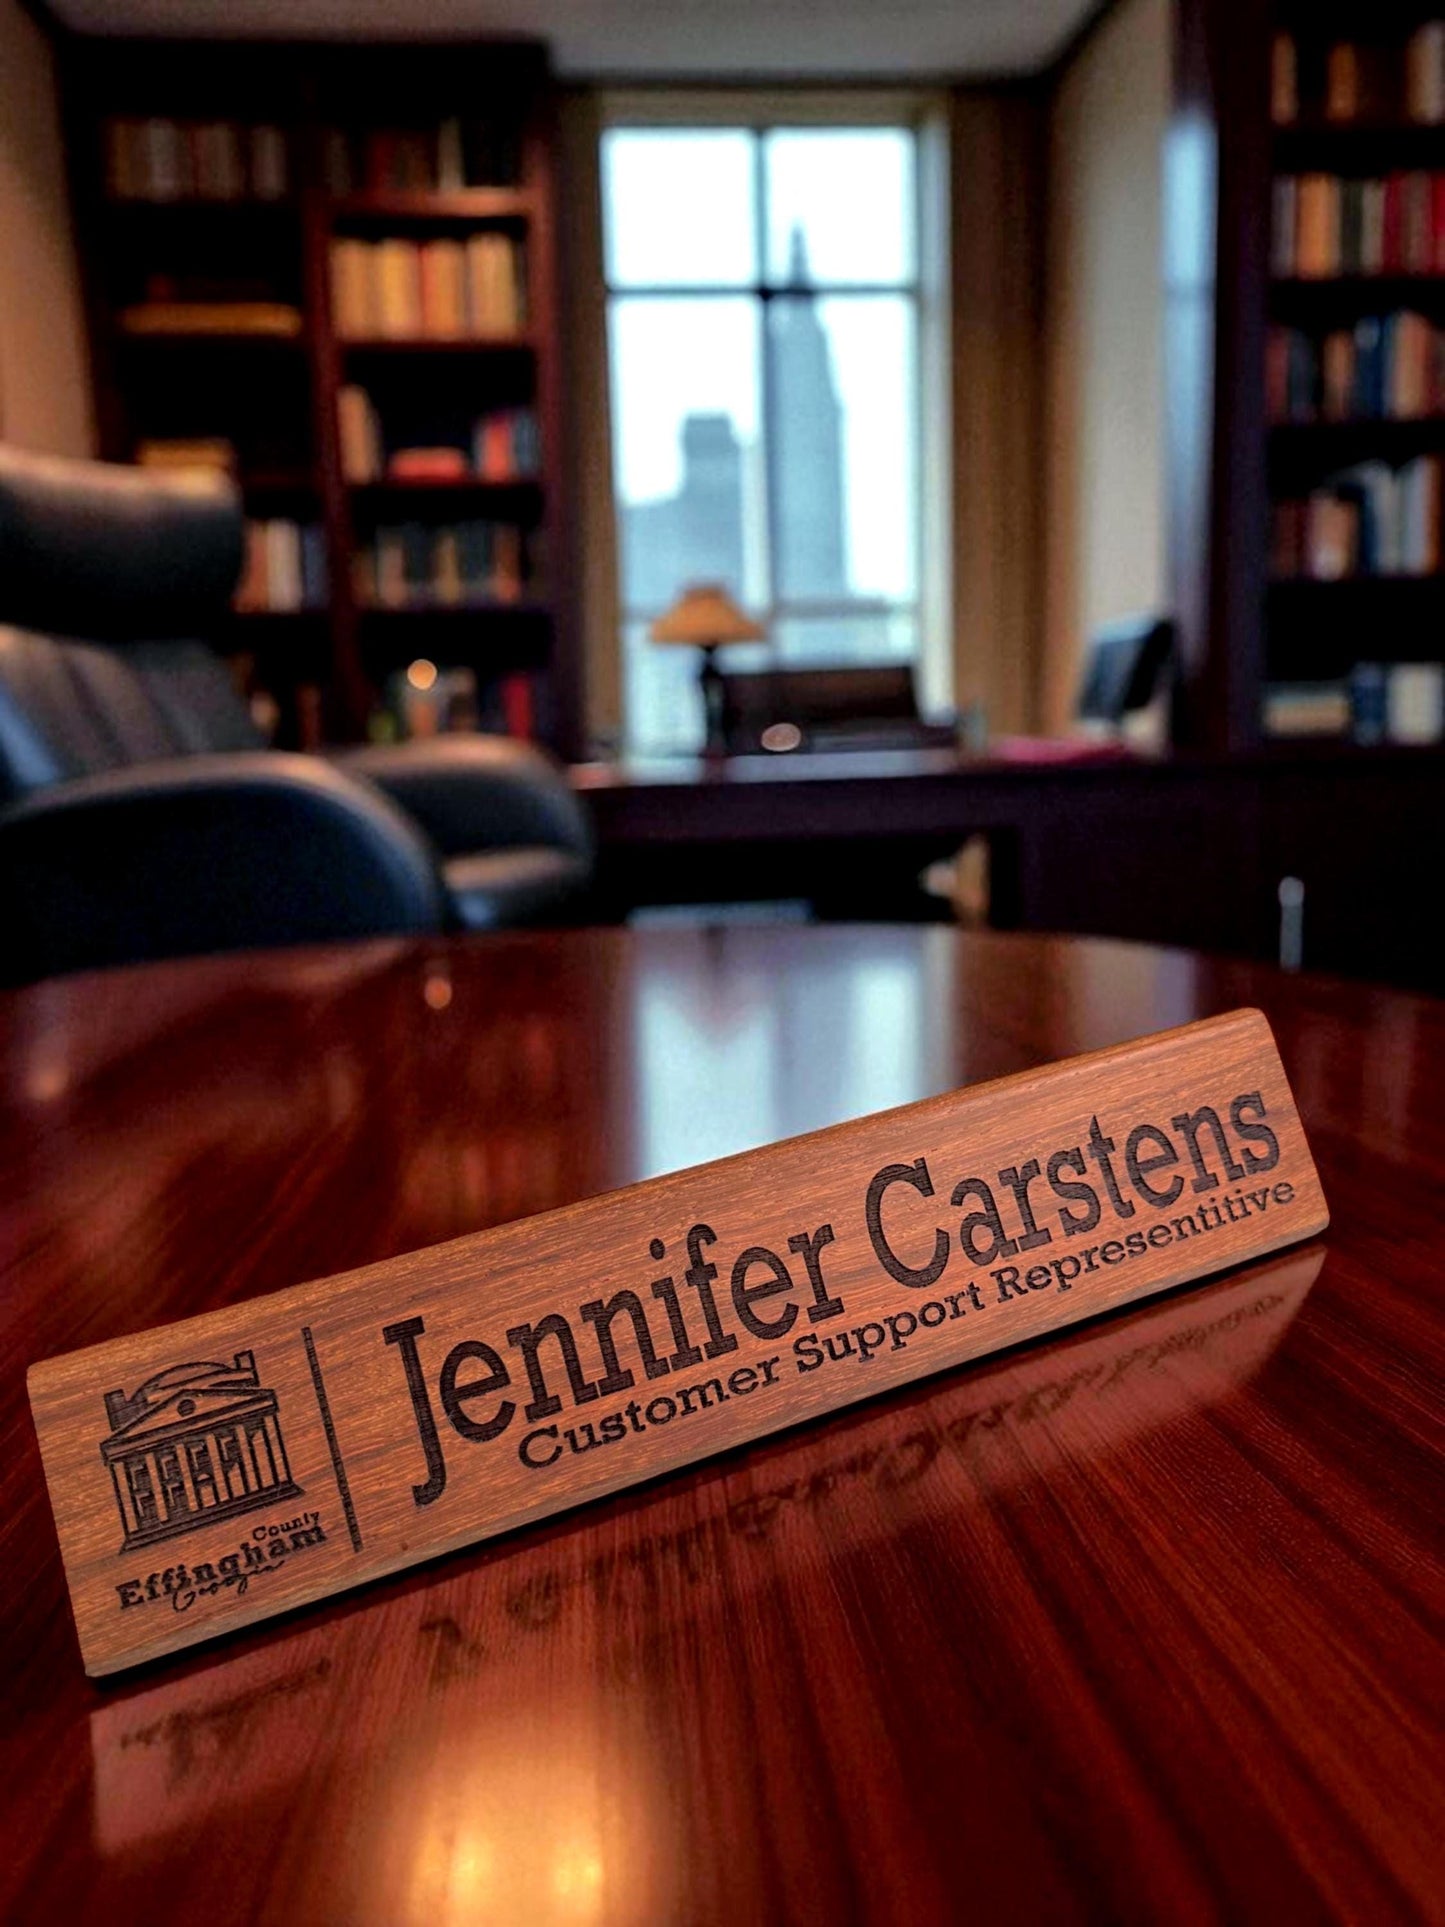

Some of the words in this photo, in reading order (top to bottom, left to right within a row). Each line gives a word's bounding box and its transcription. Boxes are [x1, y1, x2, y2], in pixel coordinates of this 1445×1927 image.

[383, 1223, 843, 1507] Jennifer
[865, 1091, 1281, 1289] Carstens
[518, 1357, 780, 1469] Customer
[794, 1281, 986, 1373] Support
[990, 1181, 1296, 1303] Representitive
[116, 1527, 328, 1609] Effingham
[253, 1510, 320, 1541] County
